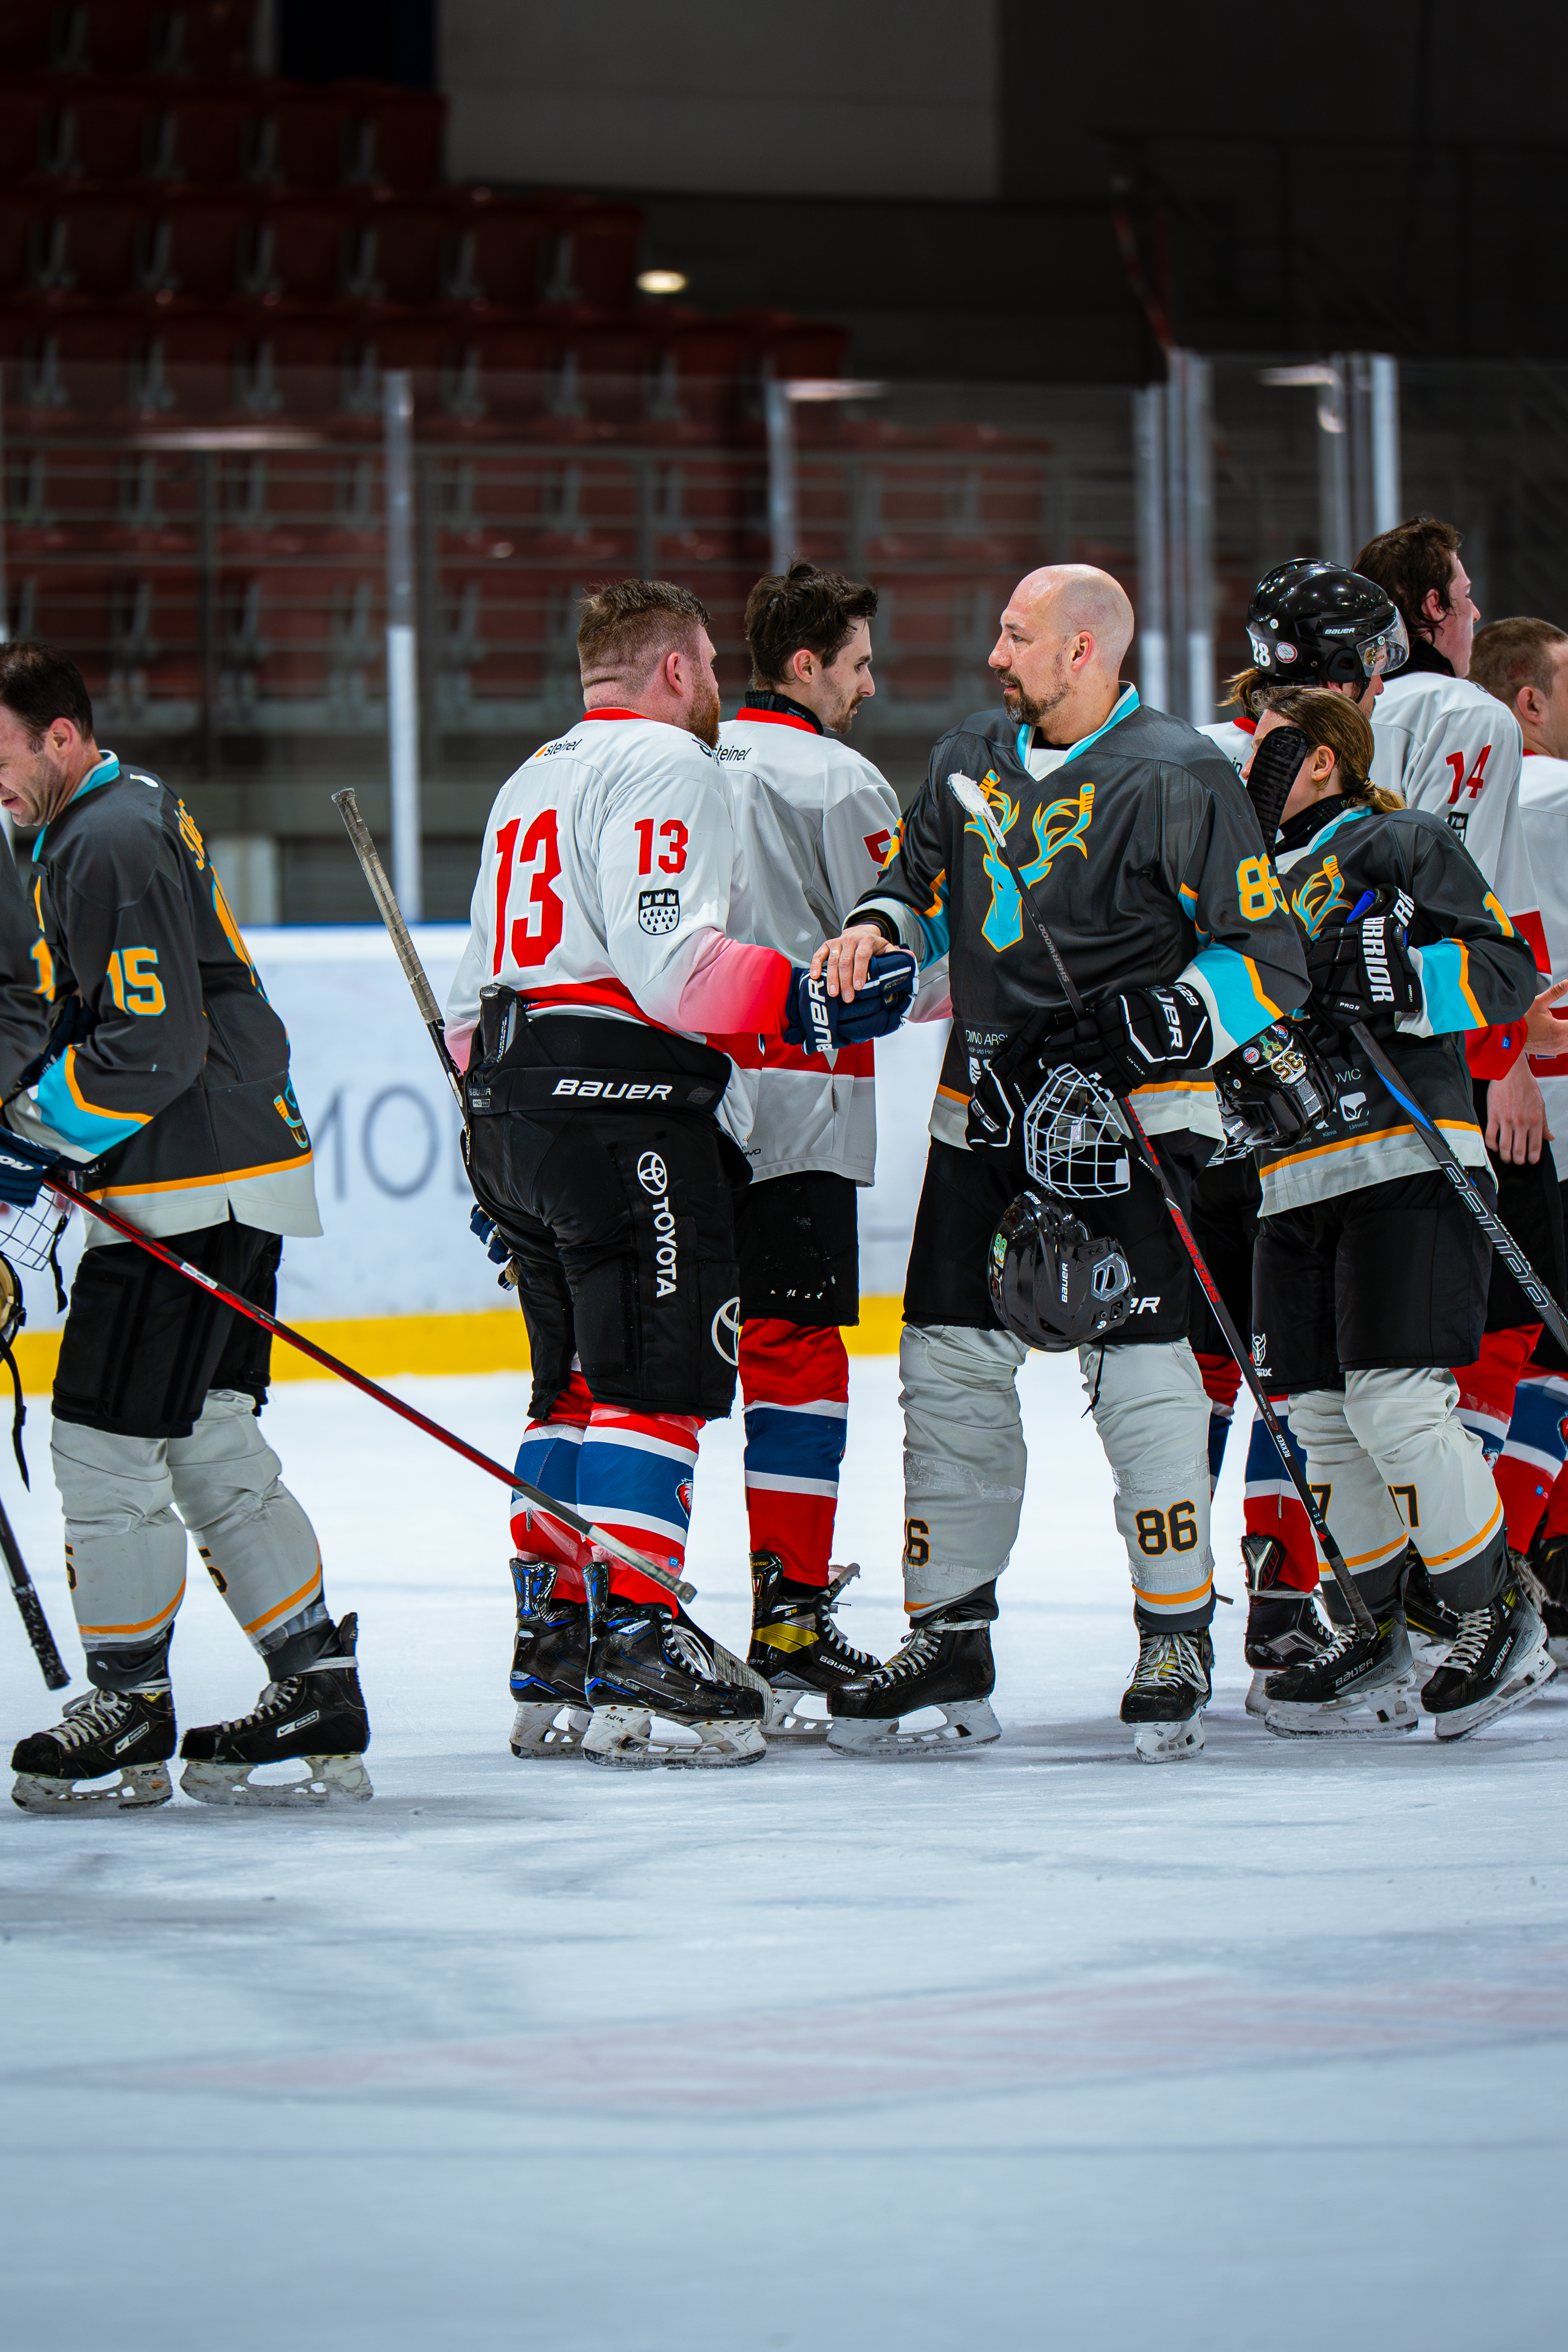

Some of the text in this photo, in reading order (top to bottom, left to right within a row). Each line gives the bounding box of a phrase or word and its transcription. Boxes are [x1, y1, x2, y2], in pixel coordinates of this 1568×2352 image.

[1252, 639, 1271, 667] 28
[544, 738, 583, 757] steinel
[1446, 745, 1491, 804] 14
[634, 818, 689, 875] 13
[493, 809, 563, 977] 13
[105, 946, 167, 1016] 15
[965, 1029, 982, 1044] DINO
[1272, 1051, 1304, 1083] 35
[652, 1197, 678, 1298] TOYOTA
[1276, 1434, 1291, 1458] REKKER
[905, 1517, 930, 1567] 6
[1135, 1499, 1199, 1557] 86
[606, 1672, 640, 1692] NEXUS
